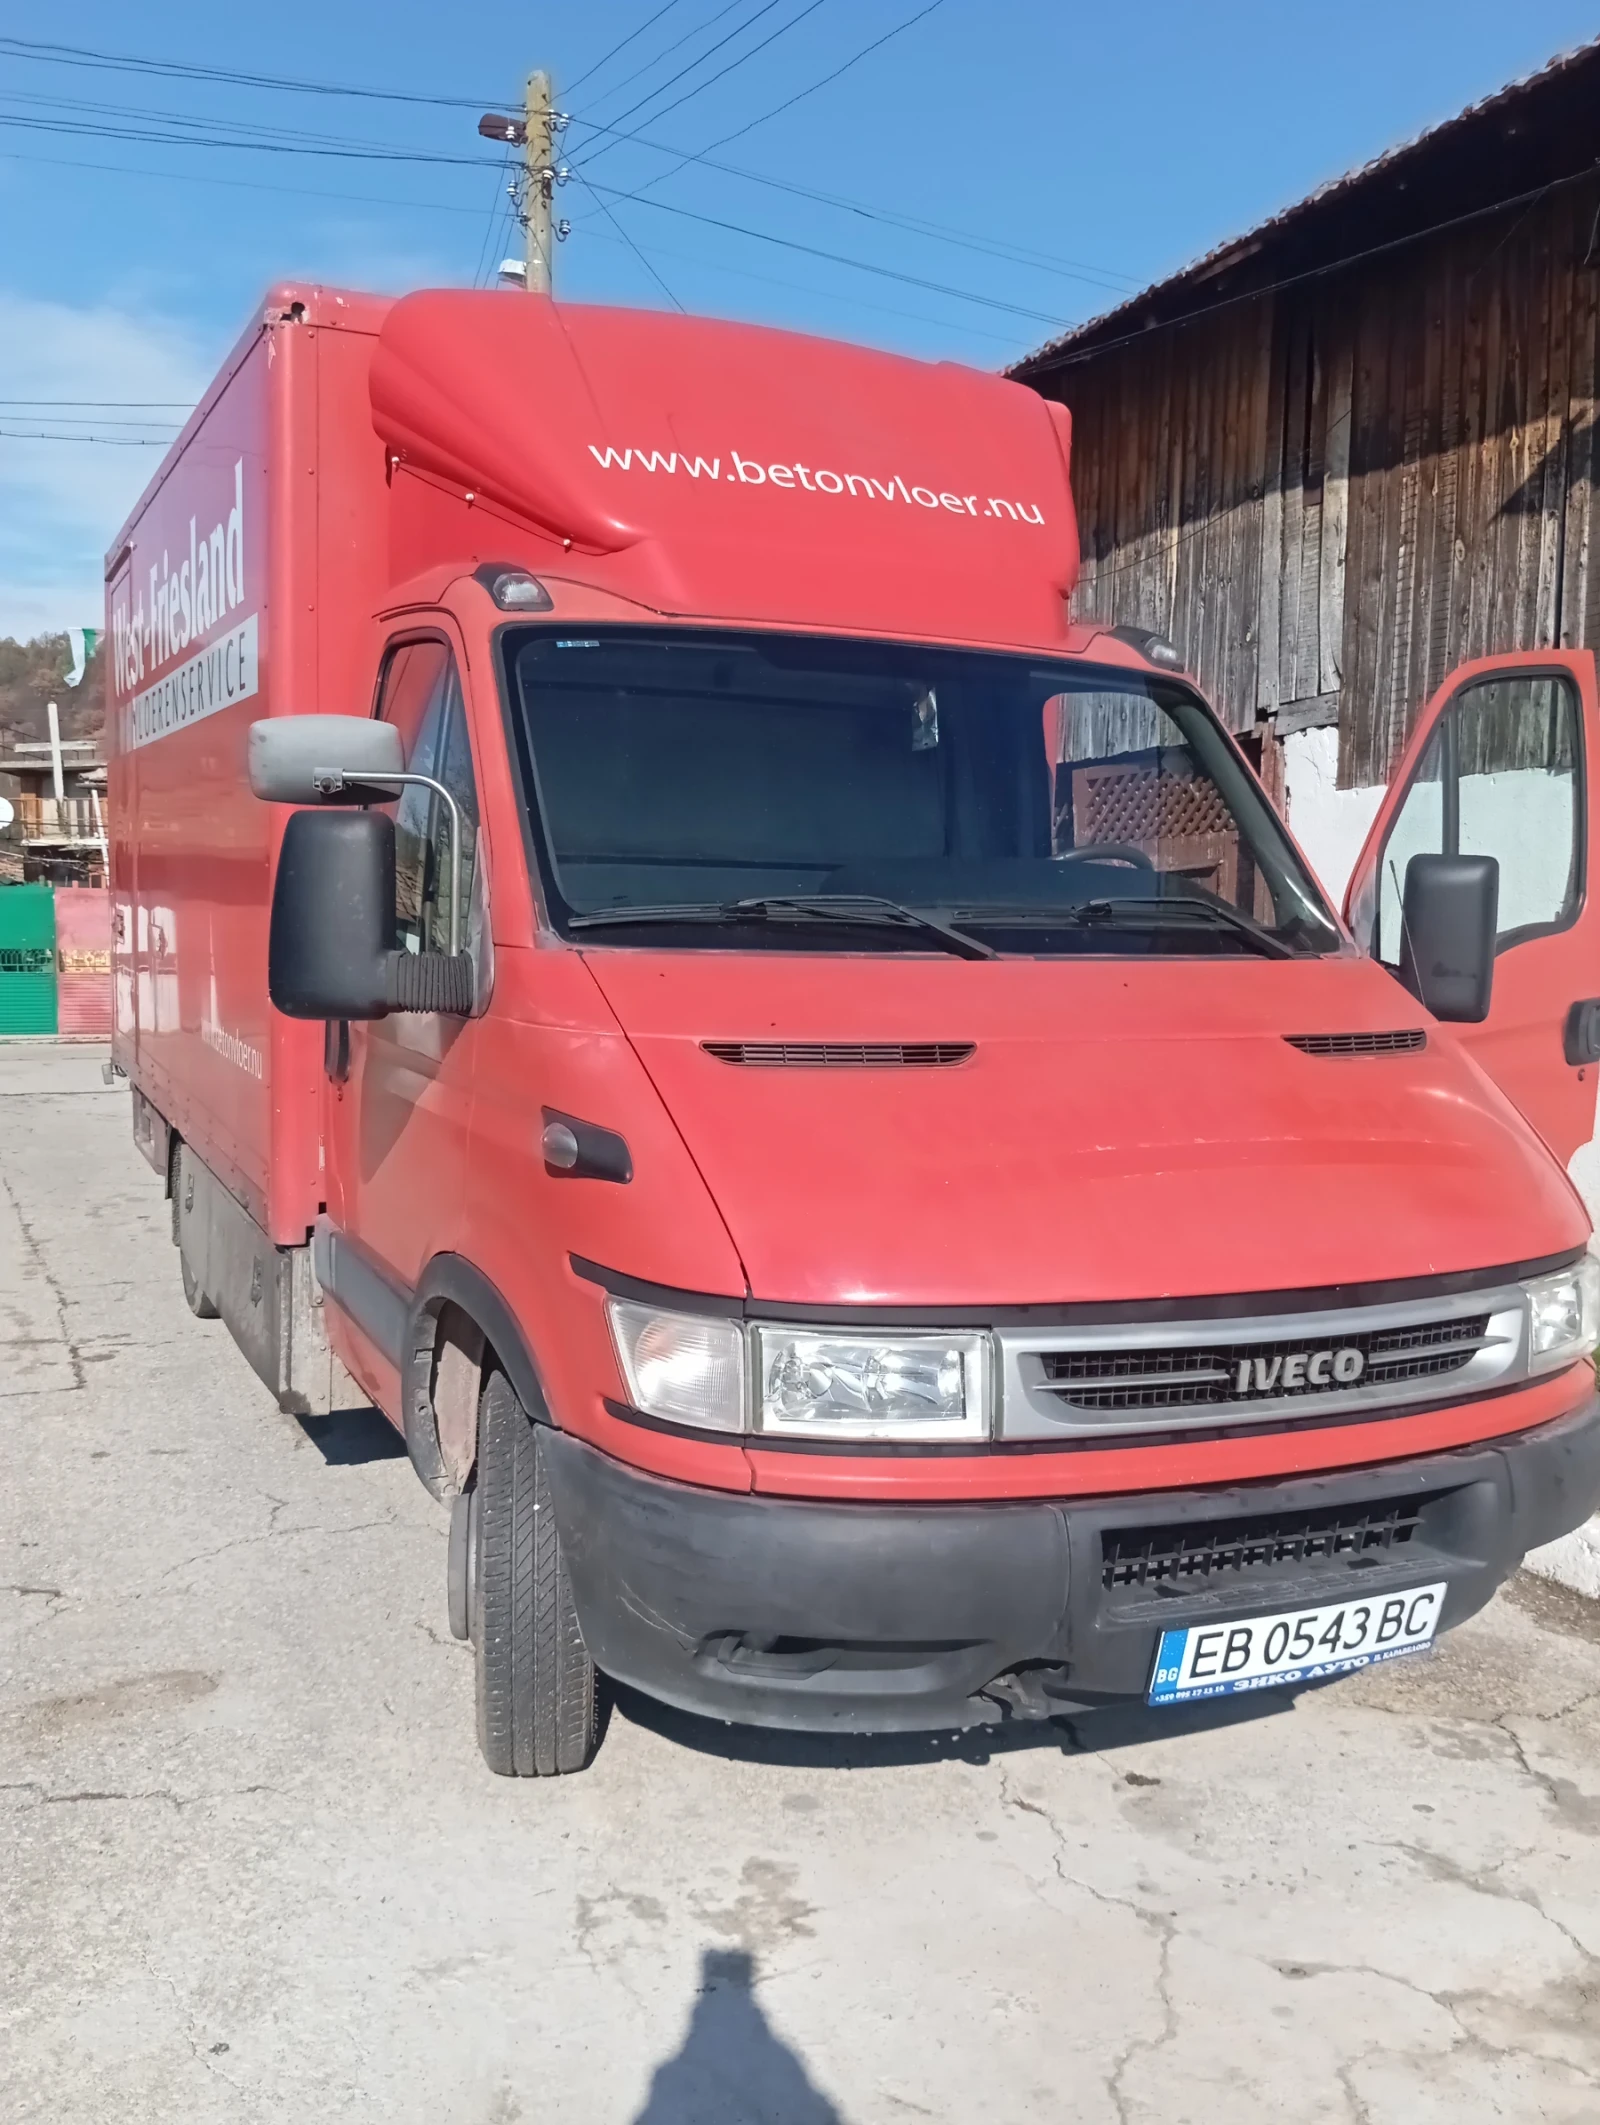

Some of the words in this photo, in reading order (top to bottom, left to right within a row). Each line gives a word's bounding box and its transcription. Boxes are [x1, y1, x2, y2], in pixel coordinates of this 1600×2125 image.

[588, 444, 1046, 525] www.betonvloer.nu
[112, 456, 245, 698] West-Friesland
[1236, 1347, 1364, 1392] IVECO
[1156, 1667, 1179, 1684] BG
[1189, 1627, 1253, 1680] EB
[1263, 1606, 1371, 1666] 0543
[1375, 1592, 1435, 1644] BC
